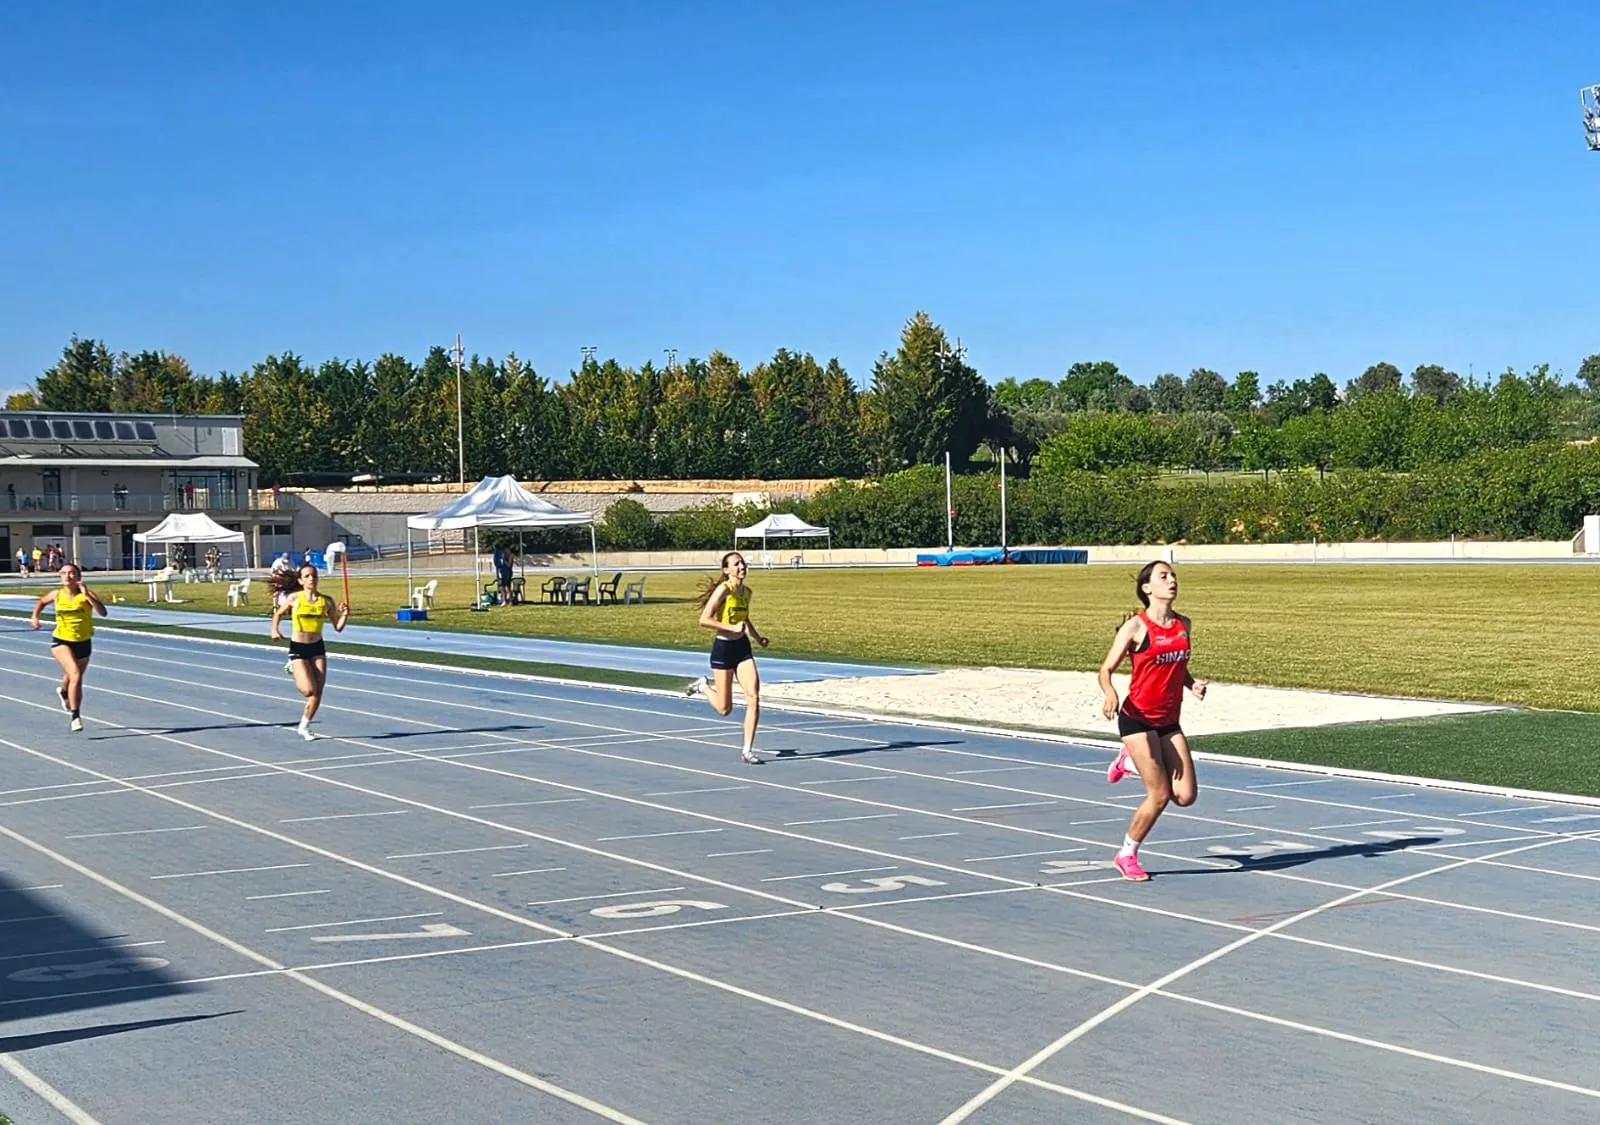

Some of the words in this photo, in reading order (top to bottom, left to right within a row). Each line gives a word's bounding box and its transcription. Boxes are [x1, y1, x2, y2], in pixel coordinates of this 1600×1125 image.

[820, 875, 948, 894] 5
[589, 900, 729, 918] 6
[5, 956, 171, 982] 8
